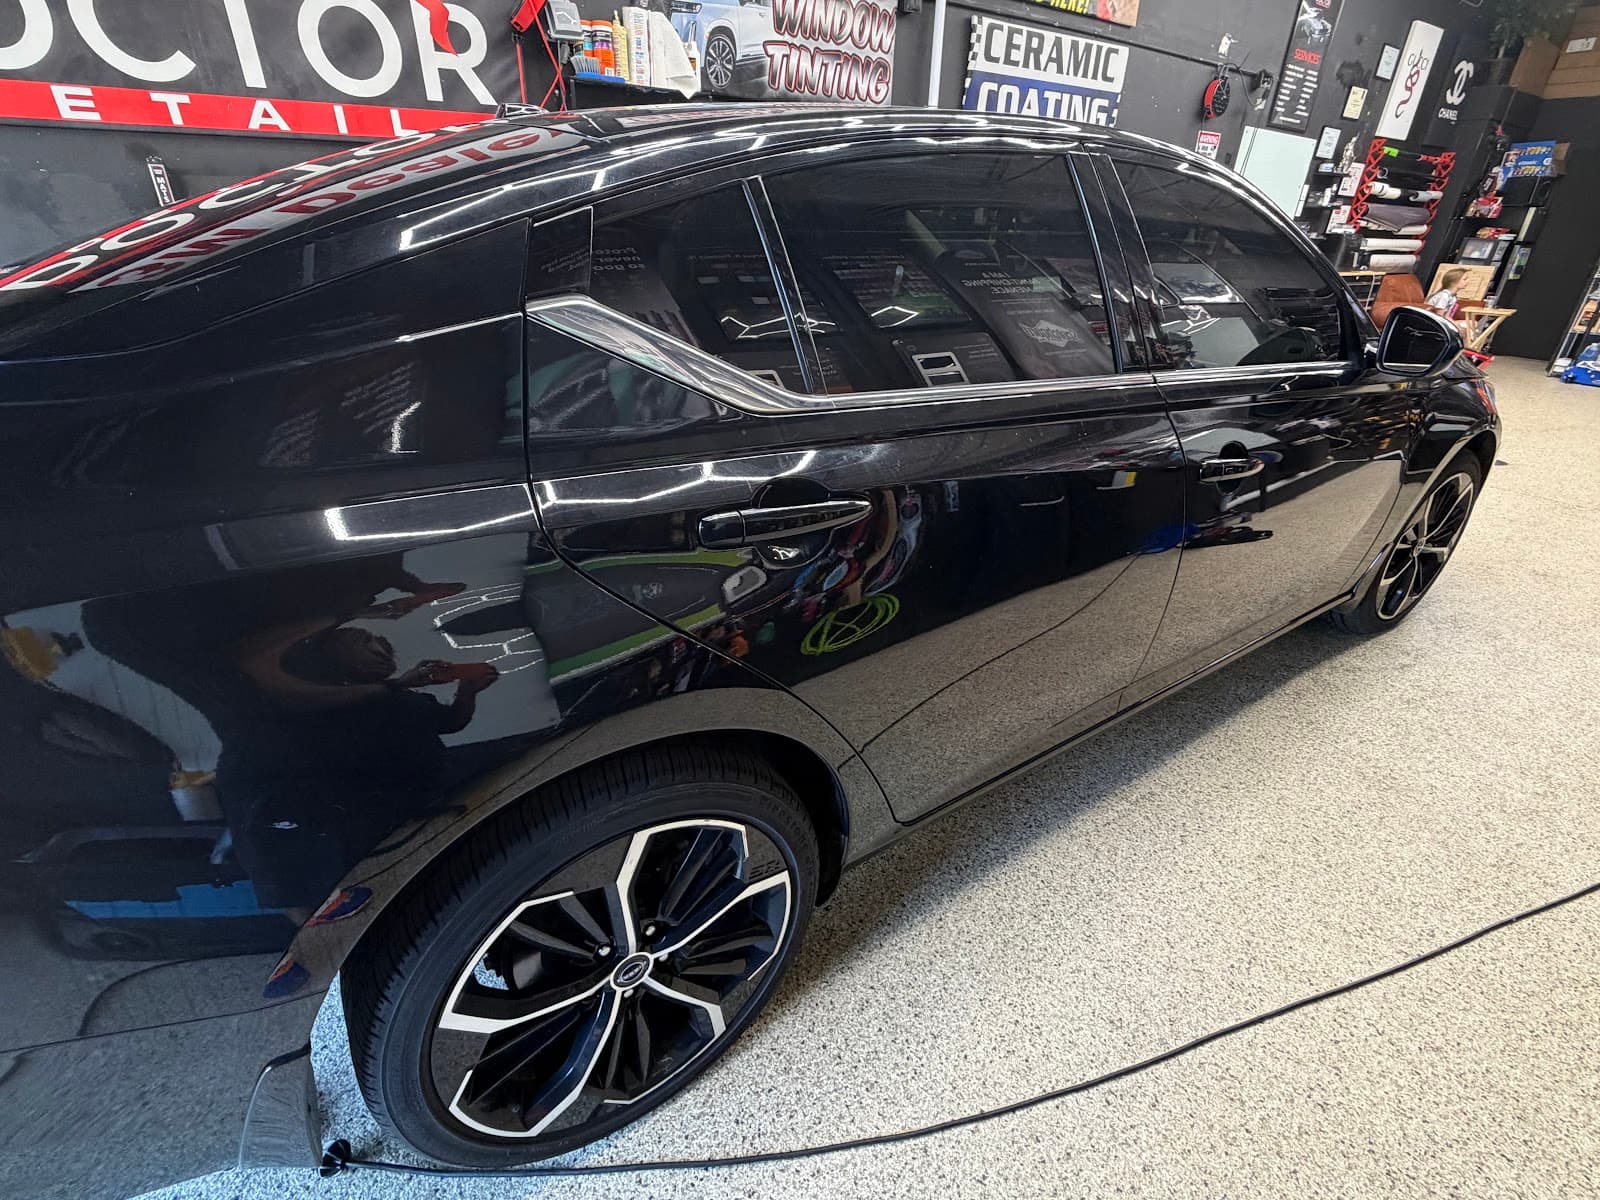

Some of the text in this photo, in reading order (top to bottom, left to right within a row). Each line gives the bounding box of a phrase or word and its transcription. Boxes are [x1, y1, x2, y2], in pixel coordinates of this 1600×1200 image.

[772, 0, 896, 53] WINDOW
[984, 22, 1119, 83] CERAMIC
[763, 41, 891, 104] TINTING
[976, 81, 1109, 126] COATING
